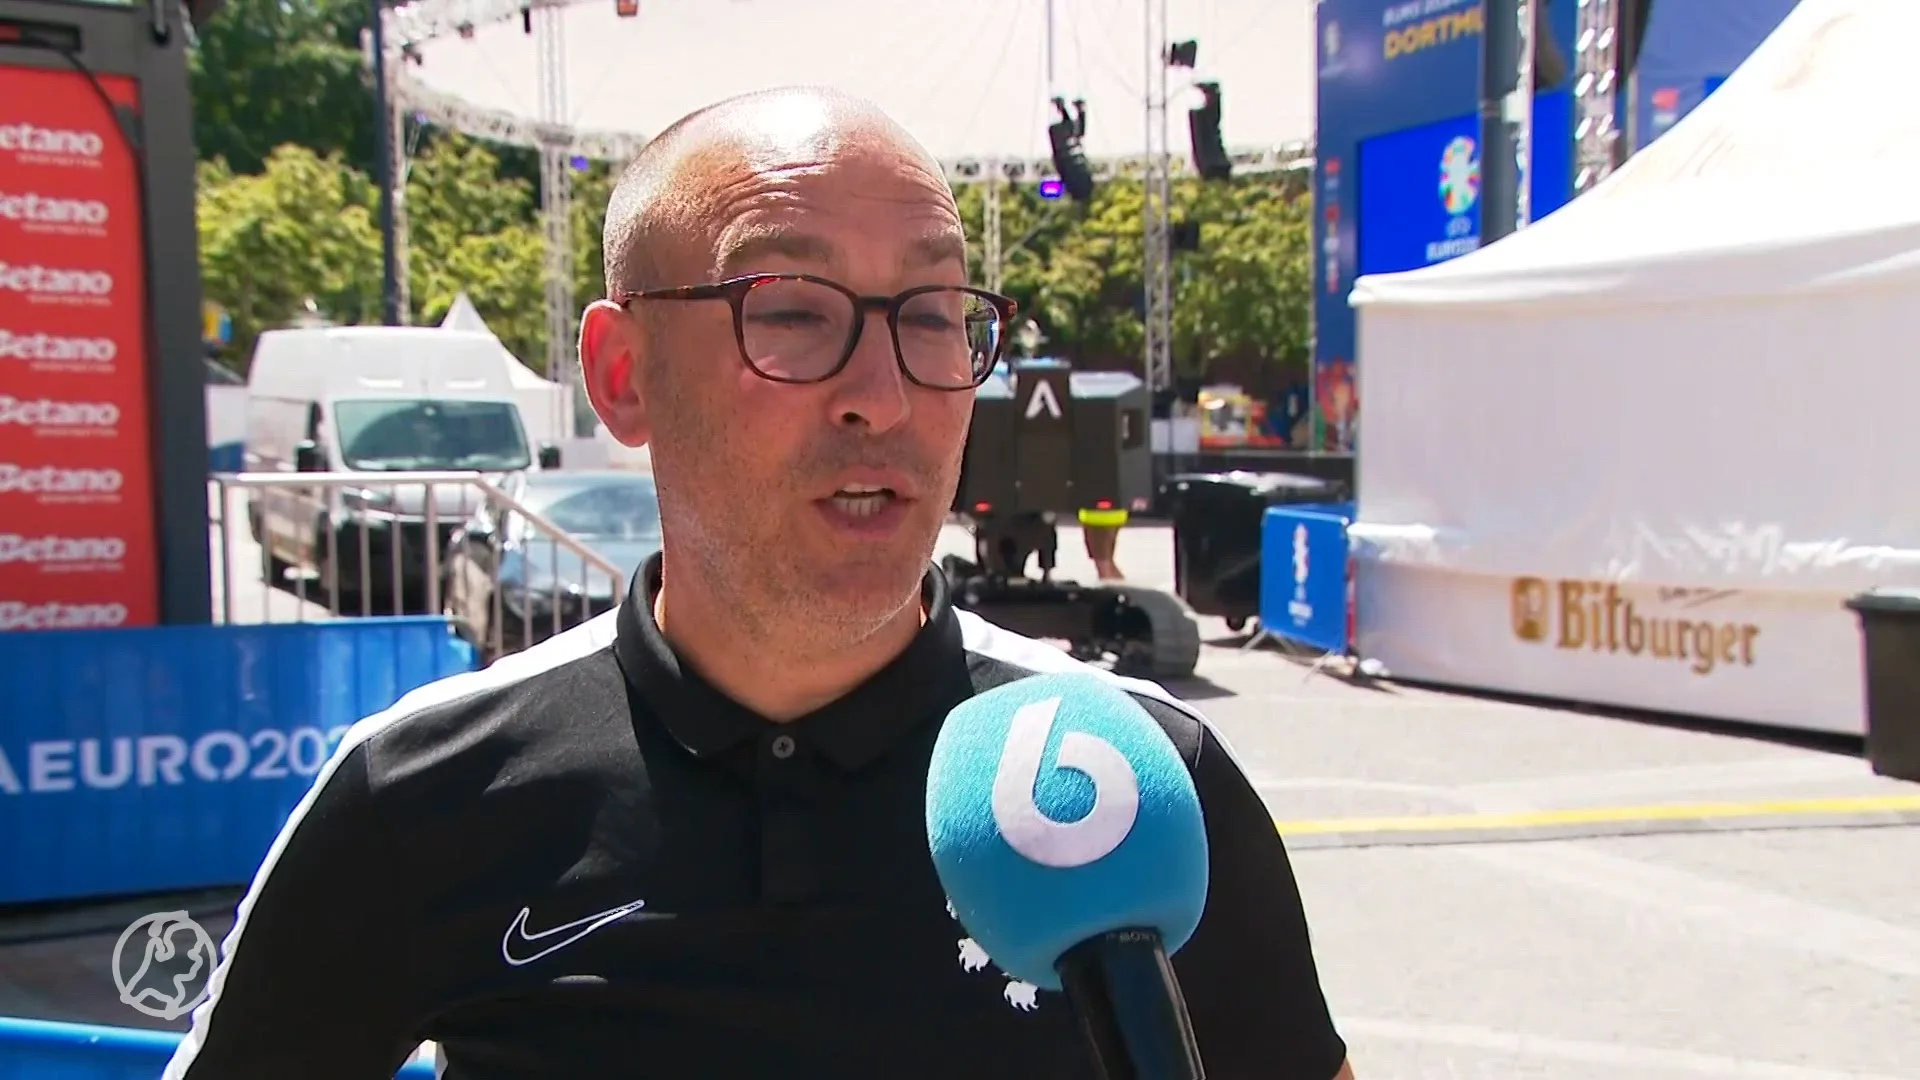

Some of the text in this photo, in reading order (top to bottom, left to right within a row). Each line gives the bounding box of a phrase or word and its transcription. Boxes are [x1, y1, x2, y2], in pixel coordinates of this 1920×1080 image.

[0, 192, 109, 225] etano
[1555, 577, 1760, 675] Bitburger
[992, 697, 1138, 867] 6
